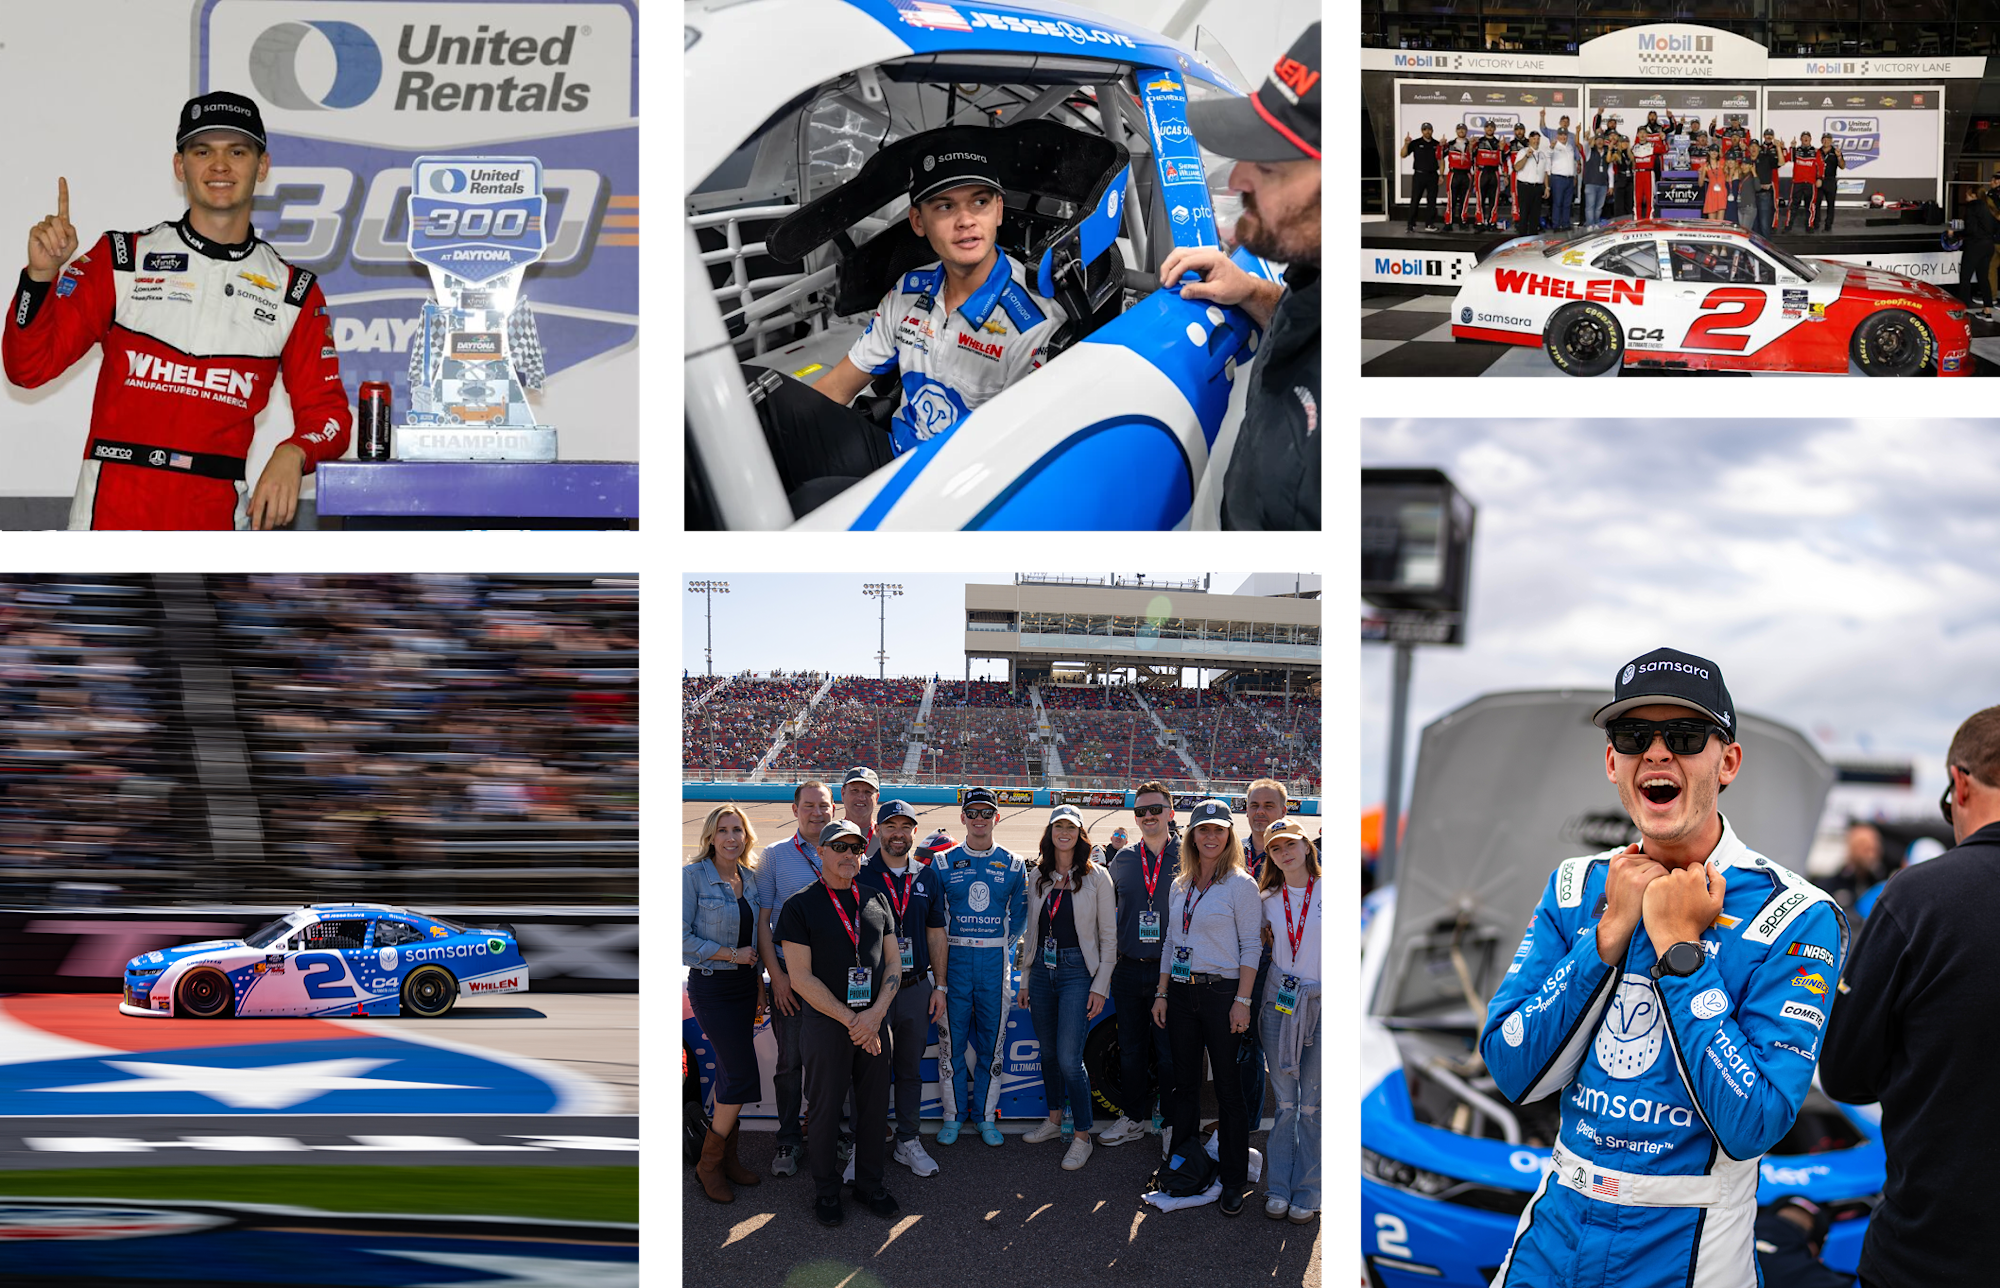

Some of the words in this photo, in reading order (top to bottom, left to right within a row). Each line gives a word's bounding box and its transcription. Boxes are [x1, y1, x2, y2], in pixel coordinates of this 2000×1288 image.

[969, 11, 1066, 38] JESSE
[1079, 26, 1136, 49] LOVE
[398, 24, 577, 66] United
[1639, 33, 1692, 51] Mobil
[1395, 54, 1433, 67] Mobil
[1468, 58, 1514, 68] VICTORY
[1516, 59, 1545, 70] LANE
[1638, 65, 1683, 75] VICTORY
[1685, 66, 1713, 76] LANE
[1806, 62, 1841, 74] Mobil
[1874, 63, 1919, 73] VICTORY
[1921, 62, 1951, 72] LANE
[394, 70, 591, 113] Rentals
[203, 104, 252, 117] samsara
[1488, 116, 1512, 124] United
[938, 152, 988, 164] samsara
[470, 169, 520, 182] United
[470, 182, 525, 195] Rentals
[1664, 188, 1699, 202] xfinity
[425, 208, 529, 238] 300
[1192, 204, 1212, 222] ptc
[441, 253, 452, 261] AT
[453, 250, 512, 262] DAYTONA
[1375, 258, 1422, 276] Mobil
[1494, 267, 1646, 306] WHELEN
[237, 289, 278, 310] samsara
[981, 293, 997, 321] samsara
[1007, 291, 1032, 321] samsara
[1874, 298, 1923, 309] GOODYEAR
[254, 308, 276, 322] C4
[1477, 312, 1532, 327] samsara
[1680, 286, 1768, 351] 2
[1585, 307, 1617, 350] GOODYEAR
[1628, 328, 1665, 342] C4
[457, 342, 495, 350] DAYTONA
[957, 331, 1005, 359] WHELEN
[1859, 338, 1871, 365] EAGLE
[1909, 316, 1931, 368] GOODYEAR
[1550, 345, 1569, 369] EAGLE
[125, 350, 255, 399] WHELEN
[124, 378, 199, 397] MANUFACTURED
[200, 390, 211, 400] IN
[212, 393, 248, 409] AMERICA
[95, 445, 133, 460] sparco
[1638, 659, 1709, 681] samsara
[1561, 861, 1576, 903] sparco
[955, 915, 1001, 924] samsara
[1759, 892, 1809, 938] sparco
[405, 943, 487, 962] samsara
[1803, 943, 1835, 968] NASCA
[295, 953, 357, 1000] 2
[372, 977, 400, 989] C4
[468, 977, 518, 992] WHELEN
[849, 989, 870, 999] PHOENIX
[1714, 1020, 1757, 1088] msara
[1571, 1082, 1694, 1127] samsara
[1374, 1212, 1413, 1259] 2
